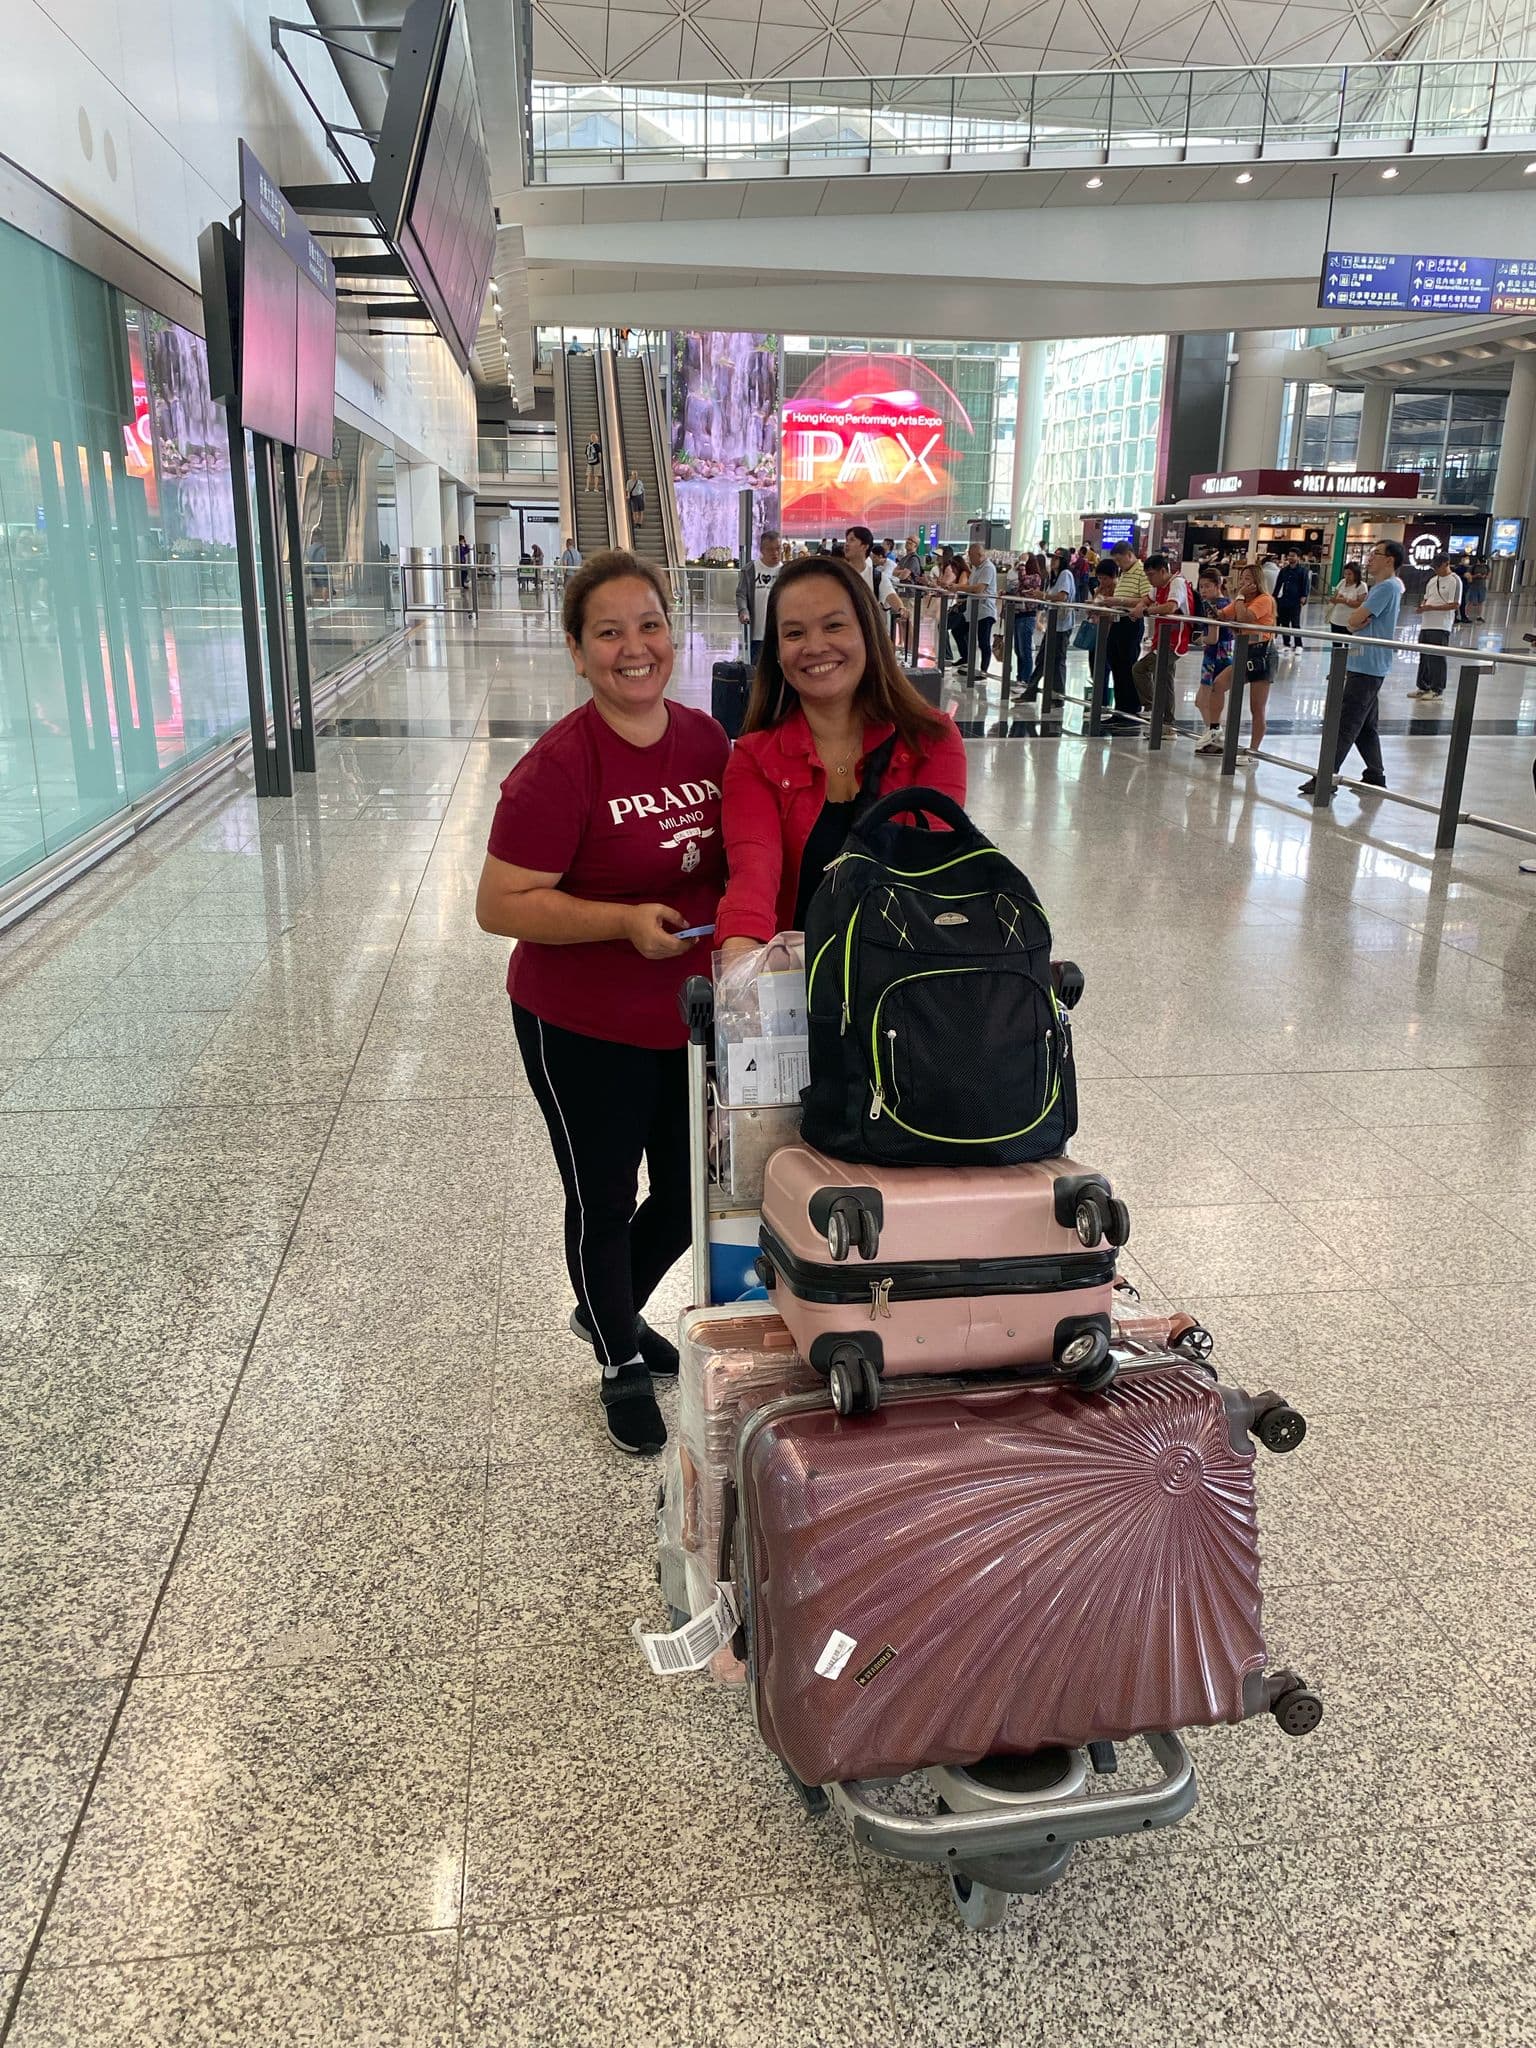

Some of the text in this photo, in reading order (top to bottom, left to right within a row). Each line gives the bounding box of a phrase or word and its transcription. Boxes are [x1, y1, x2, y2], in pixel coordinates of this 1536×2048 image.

[1459, 261, 1467, 273] 4
[793, 412, 819, 425] Hong
[820, 413, 845, 426] Kong
[846, 413, 897, 427] Performing
[898, 415, 917, 426] Arts
[918, 416, 943, 428] Expo
[795, 430, 941, 485] PAX
[1303, 475, 1377, 493] PRET A MANGER
[608, 779, 722, 825] PRADA
[658, 810, 704, 831] MILANO
